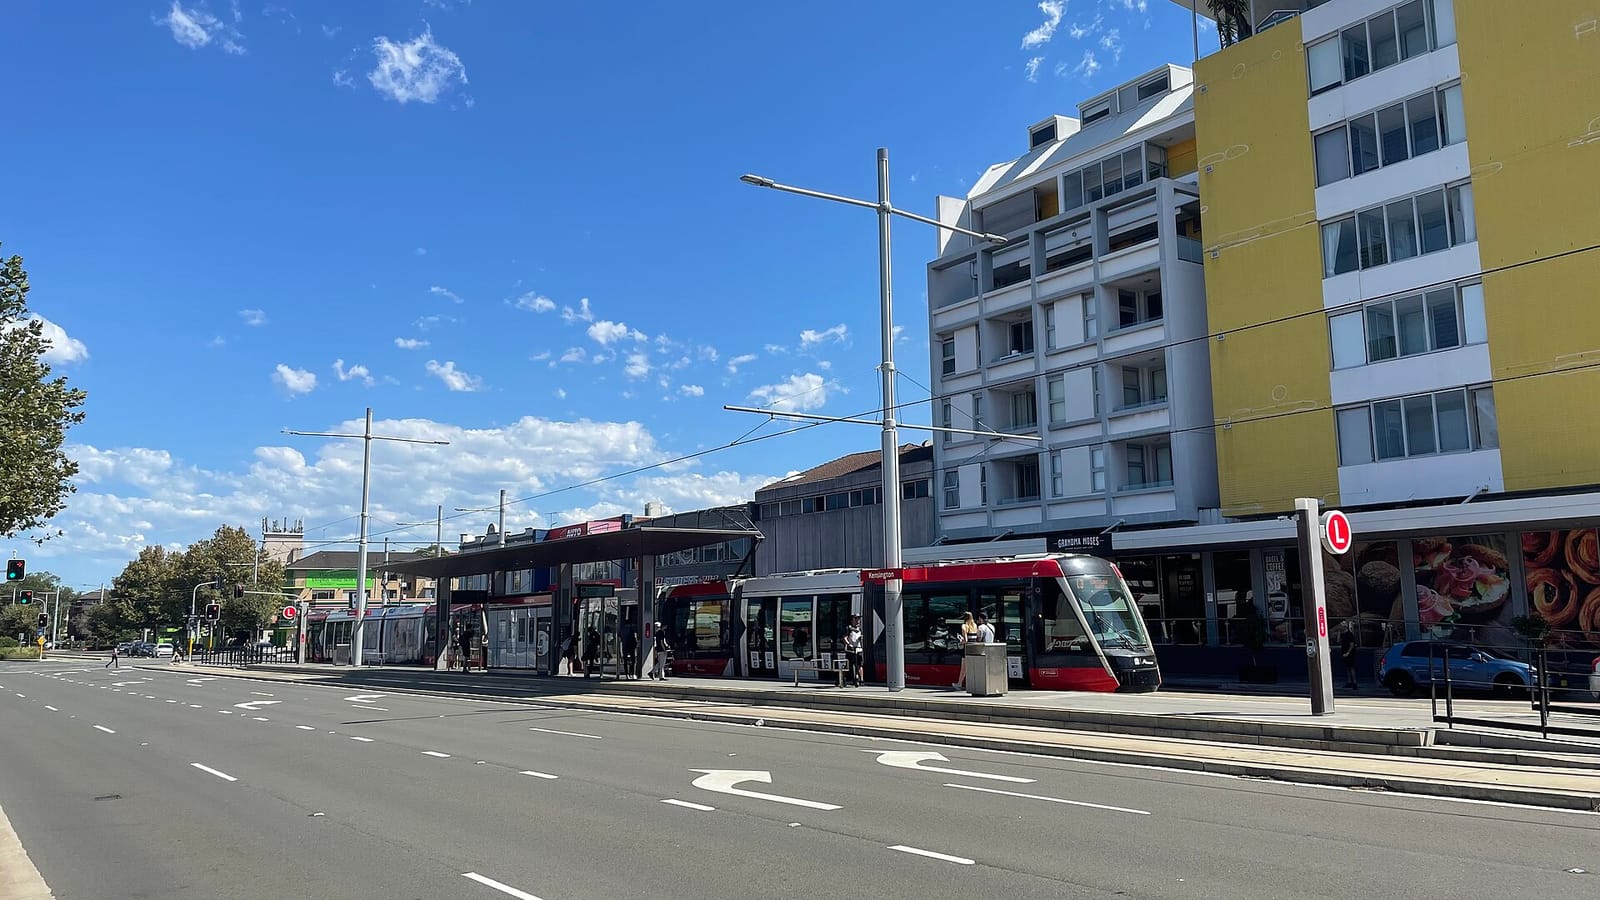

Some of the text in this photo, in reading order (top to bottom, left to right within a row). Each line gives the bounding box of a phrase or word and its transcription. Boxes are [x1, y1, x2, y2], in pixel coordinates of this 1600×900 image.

[567, 528, 581, 537] AUTO
[1334, 520, 1344, 543] L
[1058, 536, 1100, 548] GRANDMA MOSES
[868, 572, 895, 580] Kensington
